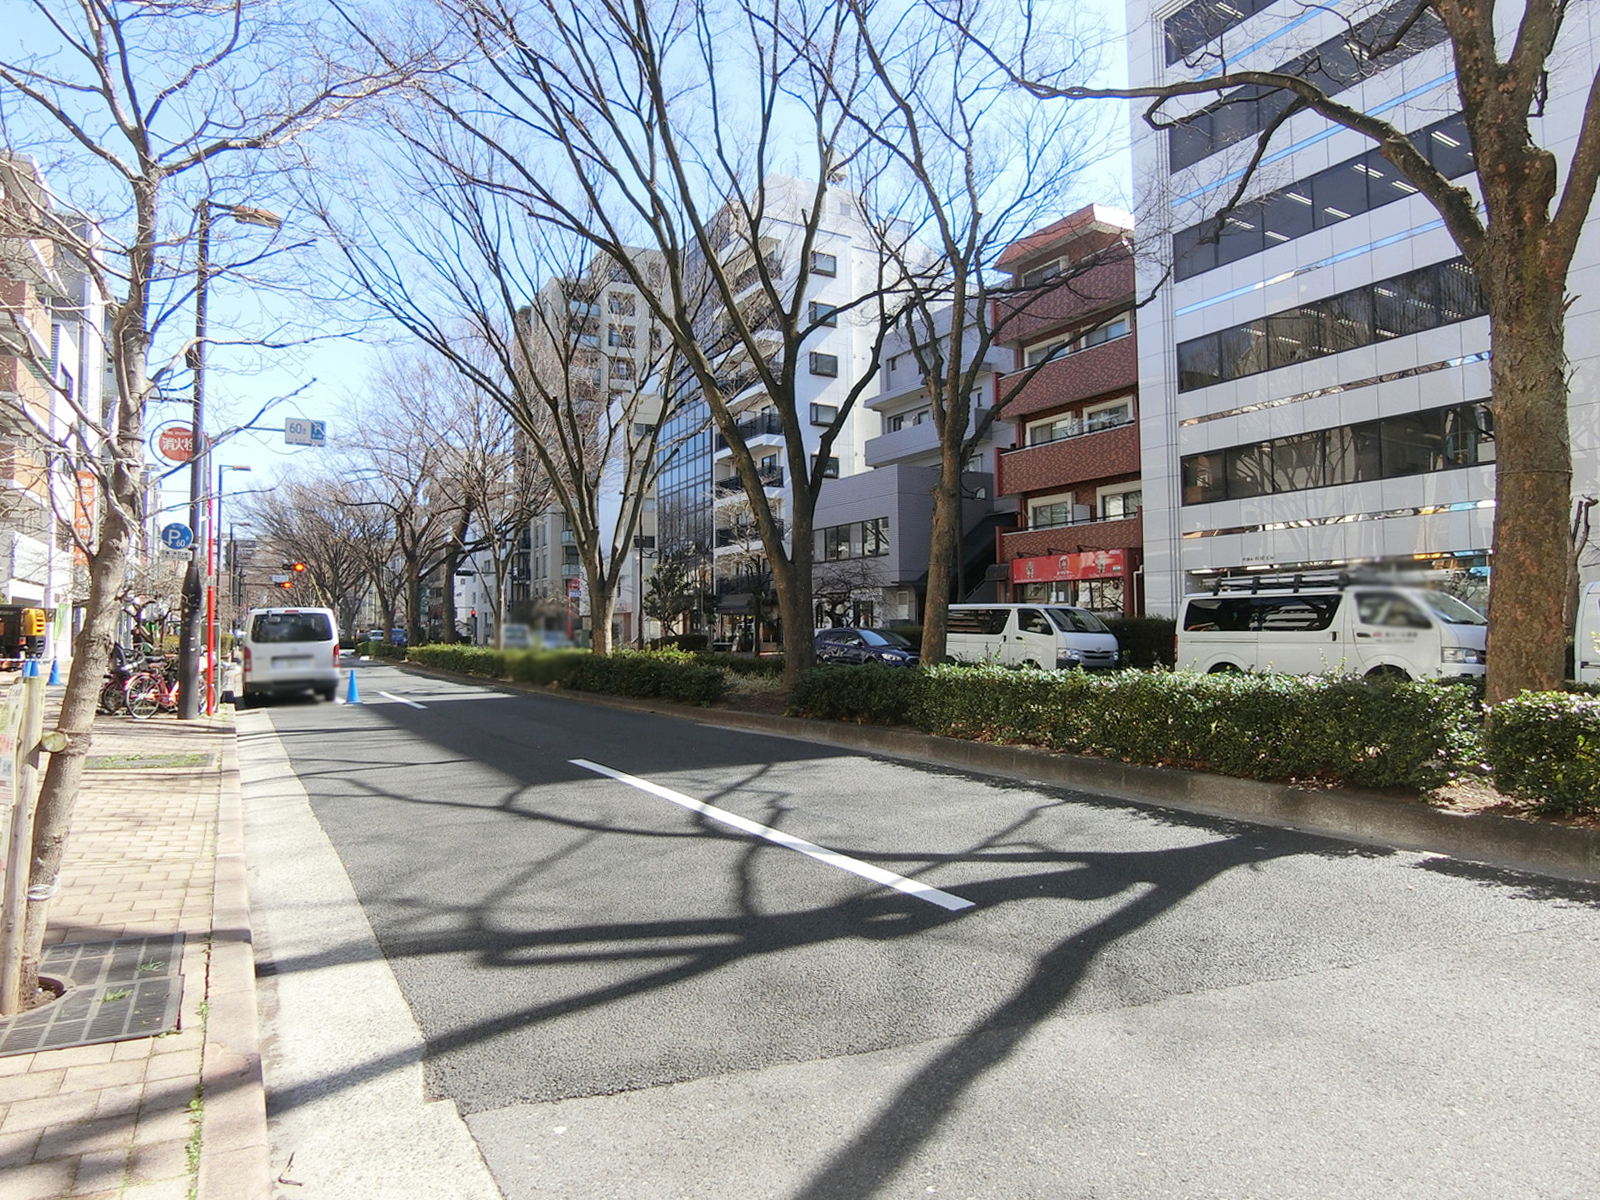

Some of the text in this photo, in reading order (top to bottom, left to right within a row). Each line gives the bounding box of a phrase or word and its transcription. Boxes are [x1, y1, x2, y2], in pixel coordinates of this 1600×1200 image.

[162, 437, 193, 452] 消火栓
[168, 529, 181, 546] P
